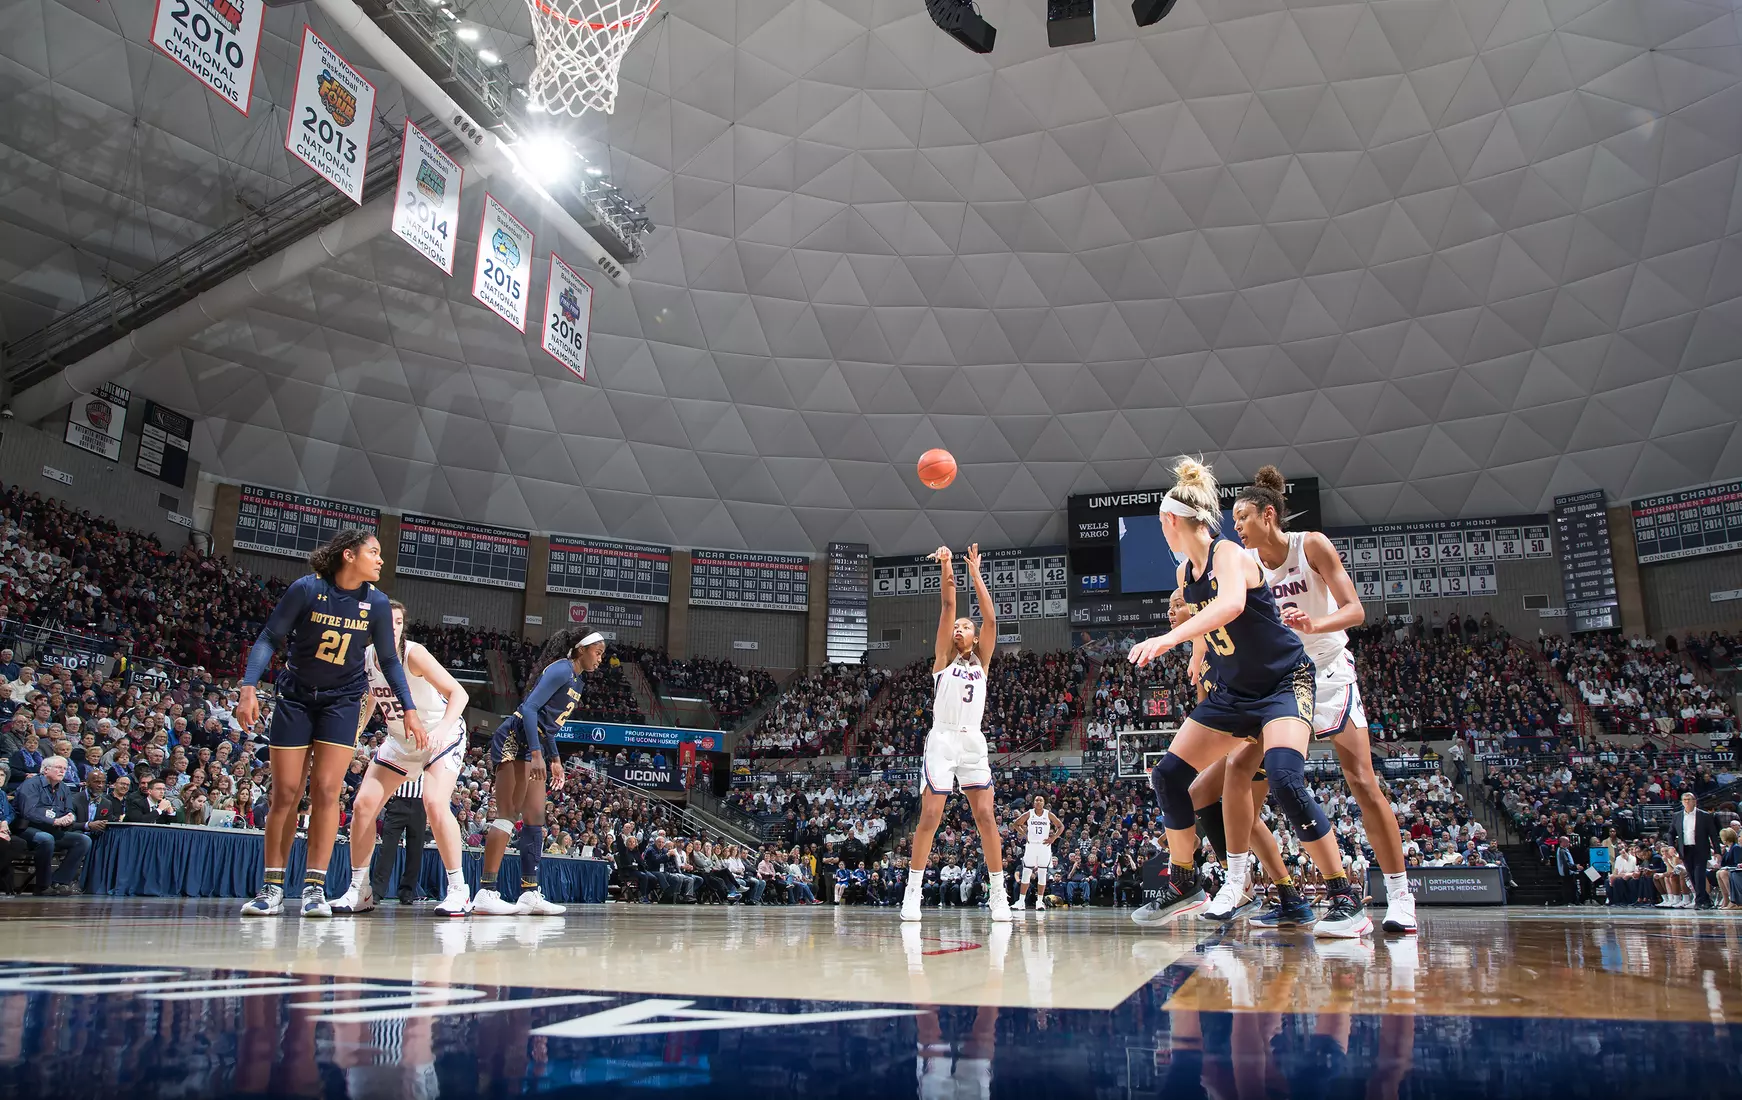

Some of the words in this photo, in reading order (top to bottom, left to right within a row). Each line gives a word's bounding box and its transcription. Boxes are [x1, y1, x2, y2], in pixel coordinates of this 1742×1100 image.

[171, 0, 244, 68] 2010
[173, 27, 236, 84] NATIONAL
[312, 36, 336, 62] UConn
[339, 59, 369, 92] Women's
[165, 39, 238, 102] CHAMPIONS
[322, 56, 358, 92] Basketball
[320, 80, 354, 116] FOUR
[332, 80, 357, 106] FINAL
[303, 107, 357, 163] 2013
[303, 133, 351, 178] NATIONAL
[412, 127, 432, 149] UConn
[433, 146, 458, 172] Women's
[420, 145, 448, 174] Basketball
[297, 144, 354, 193] CHAMPIONS
[405, 191, 448, 240] 2014
[491, 200, 507, 218] UConn
[406, 216, 444, 252] NATIONAL
[402, 226, 446, 266] CHAMPIONS
[484, 259, 520, 300] 2015
[484, 281, 518, 312] NATIONAL
[480, 291, 519, 324] CHAMPIONS
[551, 313, 582, 350] 2016
[551, 334, 579, 361] NATIONAL
[548, 343, 580, 372] CHAMPIONS
[60, 473, 73, 484] 211
[244, 487, 264, 496] BIG
[270, 489, 299, 502] EAST
[305, 498, 377, 517] CONFERENCE
[1568, 492, 1602, 502] HUSKIES
[1640, 496, 1674, 508] NCAA
[244, 495, 284, 507] REGULAR
[289, 504, 323, 514] SEASON
[326, 510, 376, 524] CHAMPIONS
[262, 507, 278, 518] 1994
[283, 511, 298, 521] 1995
[1563, 506, 1577, 514] STAT
[1578, 503, 1597, 512] BOARD
[1640, 499, 1705, 515] TOURNAMENT
[1702, 505, 1721, 516] 2004
[437, 521, 465, 530] AMERICAN
[467, 526, 492, 534] ATHLETIC
[493, 530, 527, 539] CONFERENCE
[1079, 522, 1109, 530] WELLS
[1080, 530, 1109, 538] FARGO
[1406, 522, 1446, 530] HUSKIES
[1660, 526, 1677, 537] 2011
[1683, 523, 1699, 533] 2012
[1705, 519, 1722, 530] 2014
[414, 526, 467, 538] TOURNAMENT
[472, 534, 518, 545] CHAMPIONS
[238, 542, 293, 555] CONNECTICUT
[584, 548, 639, 558] APPEARANCES
[589, 541, 622, 549] INVITATION
[625, 545, 666, 554] TOURNAMENT
[1385, 548, 1404, 560] 00
[1414, 547, 1431, 559] 13
[1442, 545, 1461, 557] 42
[1474, 544, 1486, 556] 34
[1503, 542, 1514, 554] 32
[1532, 540, 1544, 552] 50
[1643, 549, 1702, 562] CONNECTICUT
[1706, 543, 1733, 552] MEN'S
[552, 552, 565, 561] 1955
[569, 554, 582, 563] 1974
[698, 559, 747, 567] TOURNAMENT
[751, 562, 804, 570] APPEARANCES
[730, 554, 803, 563] CHAMPIONSHIP
[400, 568, 449, 578] CONNECTICUT
[477, 578, 521, 588] BASKETBALL
[997, 572, 1014, 584] 44
[1047, 569, 1064, 581] 42
[1082, 575, 1106, 584] CBS
[1575, 570, 1601, 578] TURNOVERS
[879, 580, 889, 591] C
[905, 579, 911, 590] 9
[924, 577, 940, 588] 22
[1364, 583, 1375, 595] 22
[1420, 580, 1431, 592] 42
[1448, 578, 1460, 591] 13
[1480, 577, 1486, 589] 3
[1581, 580, 1599, 588] BLOCKS
[550, 587, 597, 595] CONNECTICUT
[623, 593, 665, 601] BASKETBALL
[999, 604, 1012, 614] 13
[1023, 602, 1039, 614] 22
[1575, 610, 1590, 618] TIME
[1599, 607, 1611, 615] DAY
[311, 611, 342, 627] NOTRE
[344, 618, 370, 631] DAME
[619, 619, 642, 627] CHAMPION
[1586, 615, 1612, 628] 4:39
[315, 630, 352, 666] 21
[44, 655, 59, 664] SEC
[952, 668, 982, 681] UCONN
[963, 684, 974, 703] 3
[1148, 700, 1167, 716] 30
[625, 730, 644, 738] PROUD
[1717, 752, 1734, 761] 117
[625, 770, 670, 783] UCONN
[745, 775, 757, 783] 113
[1036, 827, 1043, 835] 13
